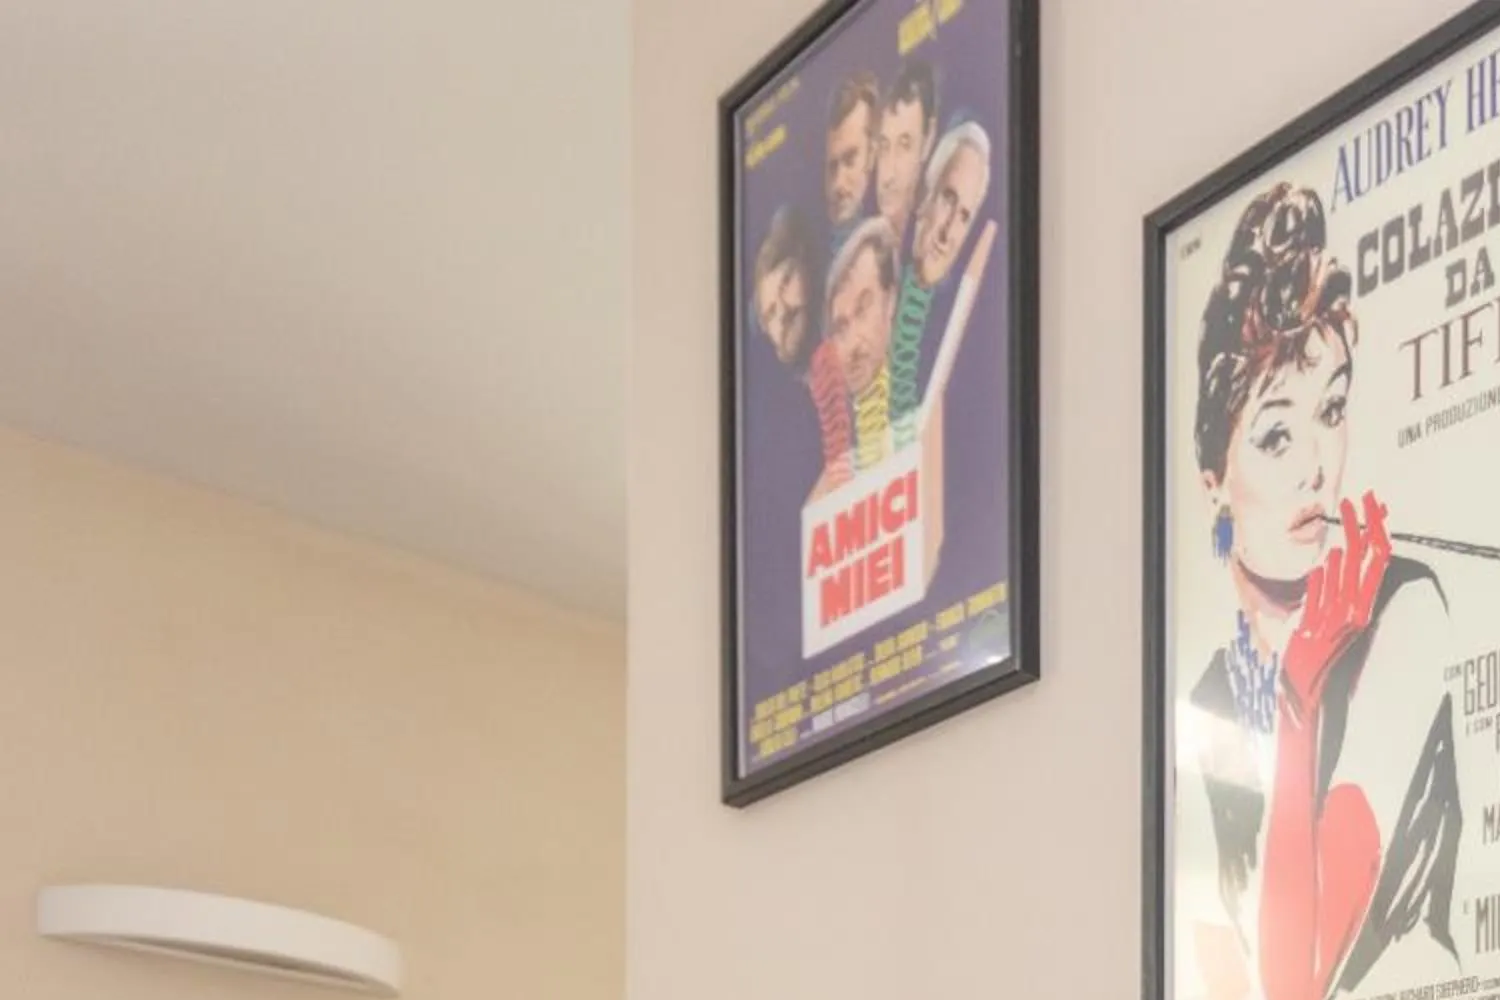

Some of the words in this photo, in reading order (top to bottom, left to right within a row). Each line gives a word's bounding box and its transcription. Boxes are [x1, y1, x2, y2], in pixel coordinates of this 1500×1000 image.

[1330, 80, 1452, 213] AUDREY
[1445, 245, 1495, 308] DA
[1397, 422, 1421, 448] UNA
[806, 469, 918, 578] AMICI
[819, 534, 905, 629] MIEI
